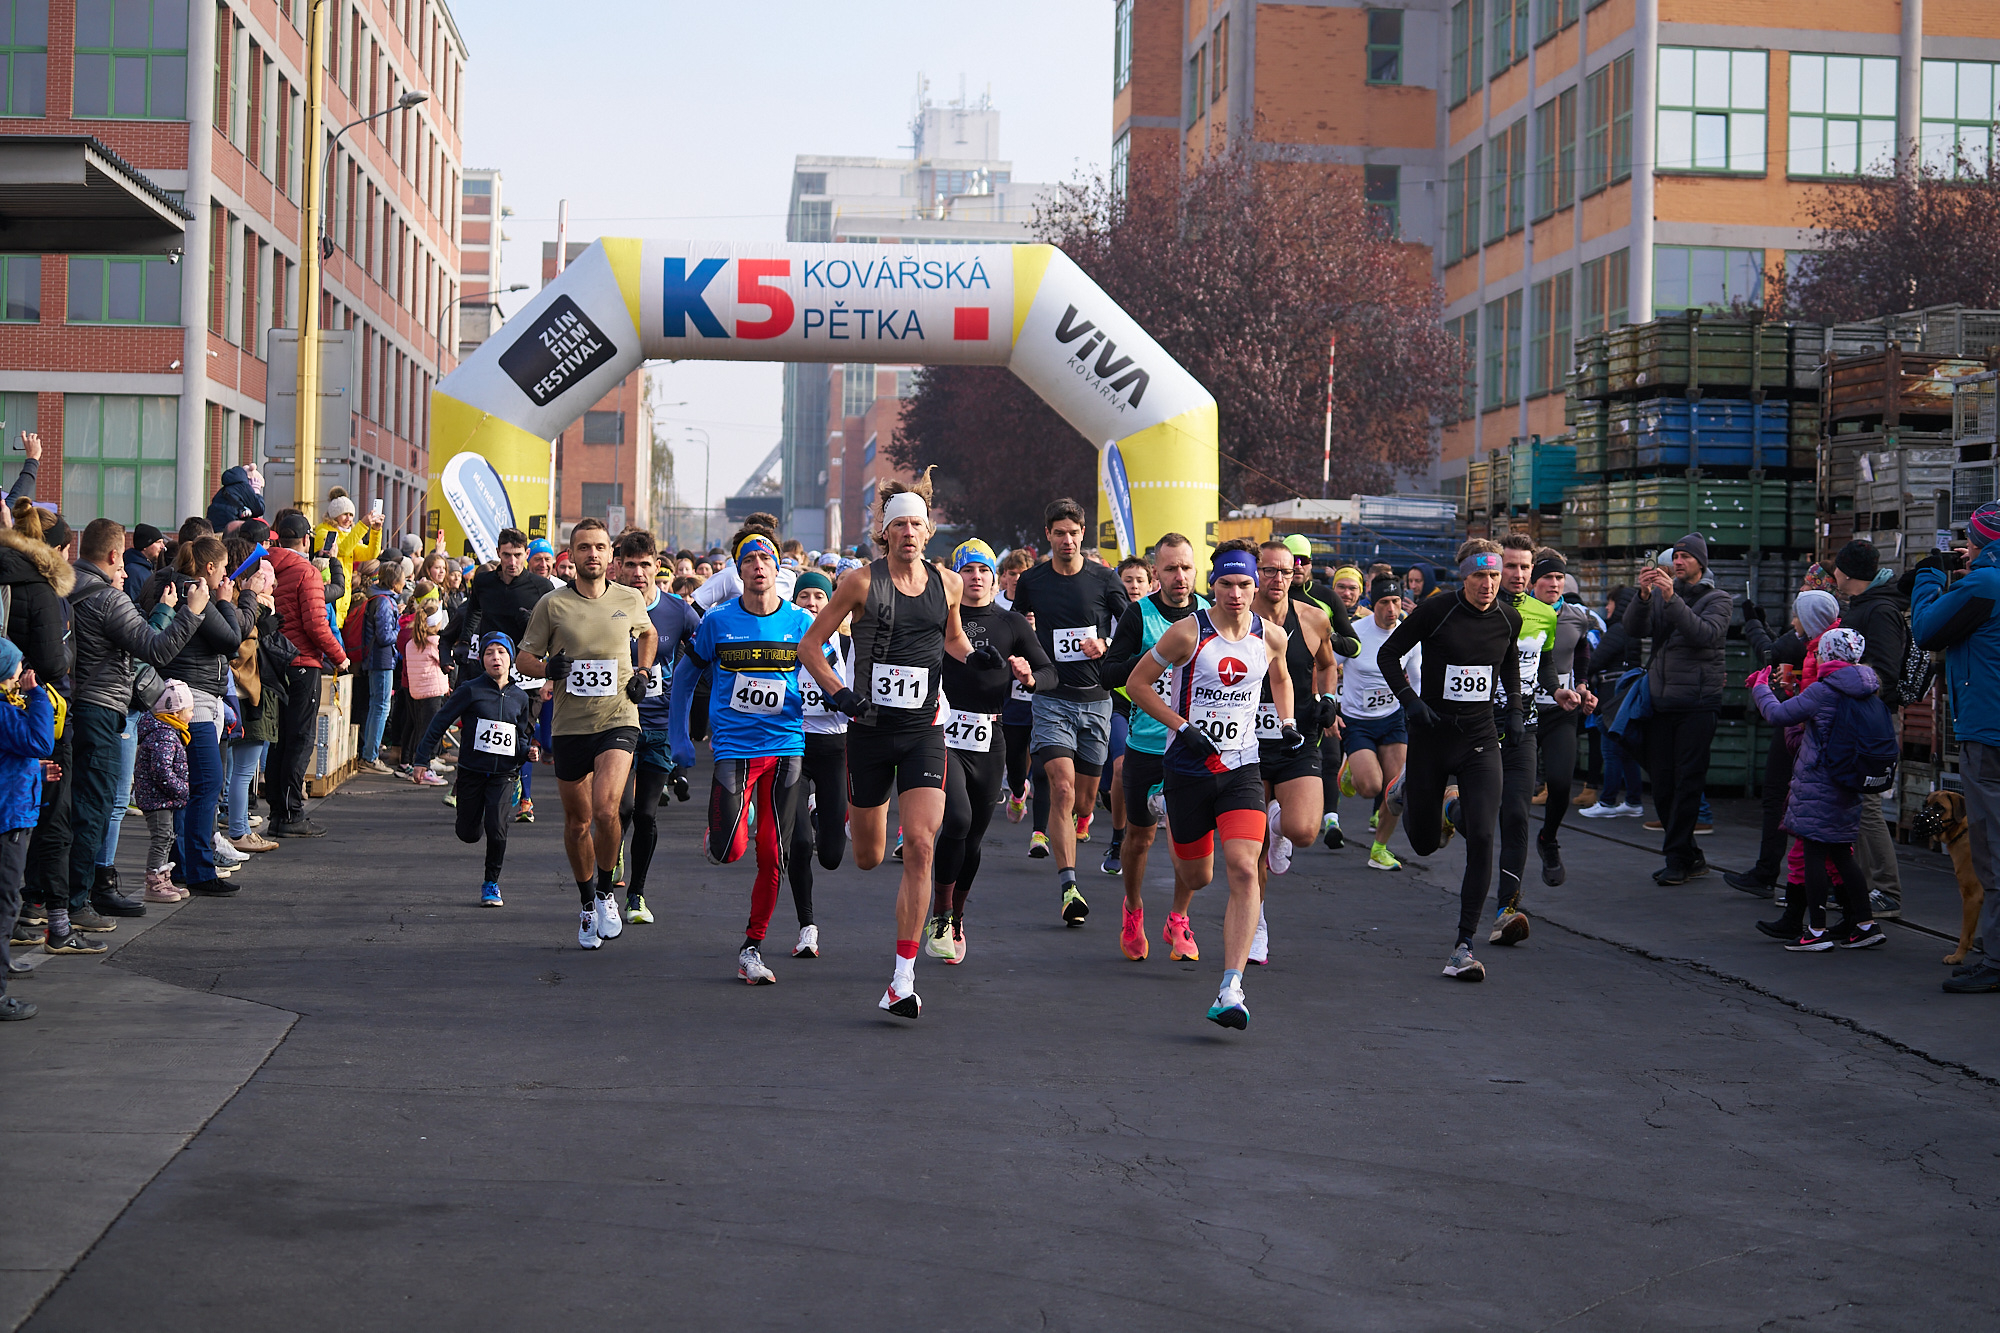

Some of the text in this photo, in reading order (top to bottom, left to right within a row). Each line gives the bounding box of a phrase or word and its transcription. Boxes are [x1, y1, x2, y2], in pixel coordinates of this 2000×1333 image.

[804, 256, 991, 289] KOVÁŘSKÁ
[664, 257, 795, 340] K5
[539, 310, 578, 348] ZLÍN
[804, 301, 925, 340] PĚTKA
[550, 322, 590, 360] FILM
[533, 338, 603, 399] FESTIVAL
[1067, 356, 1127, 413] KOVÁRNA
[1477, 555, 1497, 567] K5
[572, 671, 612, 687] 333
[890, 668, 900, 676] K5
[877, 677, 920, 698] 311
[1194, 687, 1252, 701] PROefekt
[1450, 676, 1487, 692] 398
[736, 687, 778, 708] 400
[1368, 693, 1394, 707] 253
[1206, 711, 1216, 719] K5
[1255, 713, 1279, 730] 36
[480, 730, 511, 746] 458
[945, 721, 987, 742] 476
